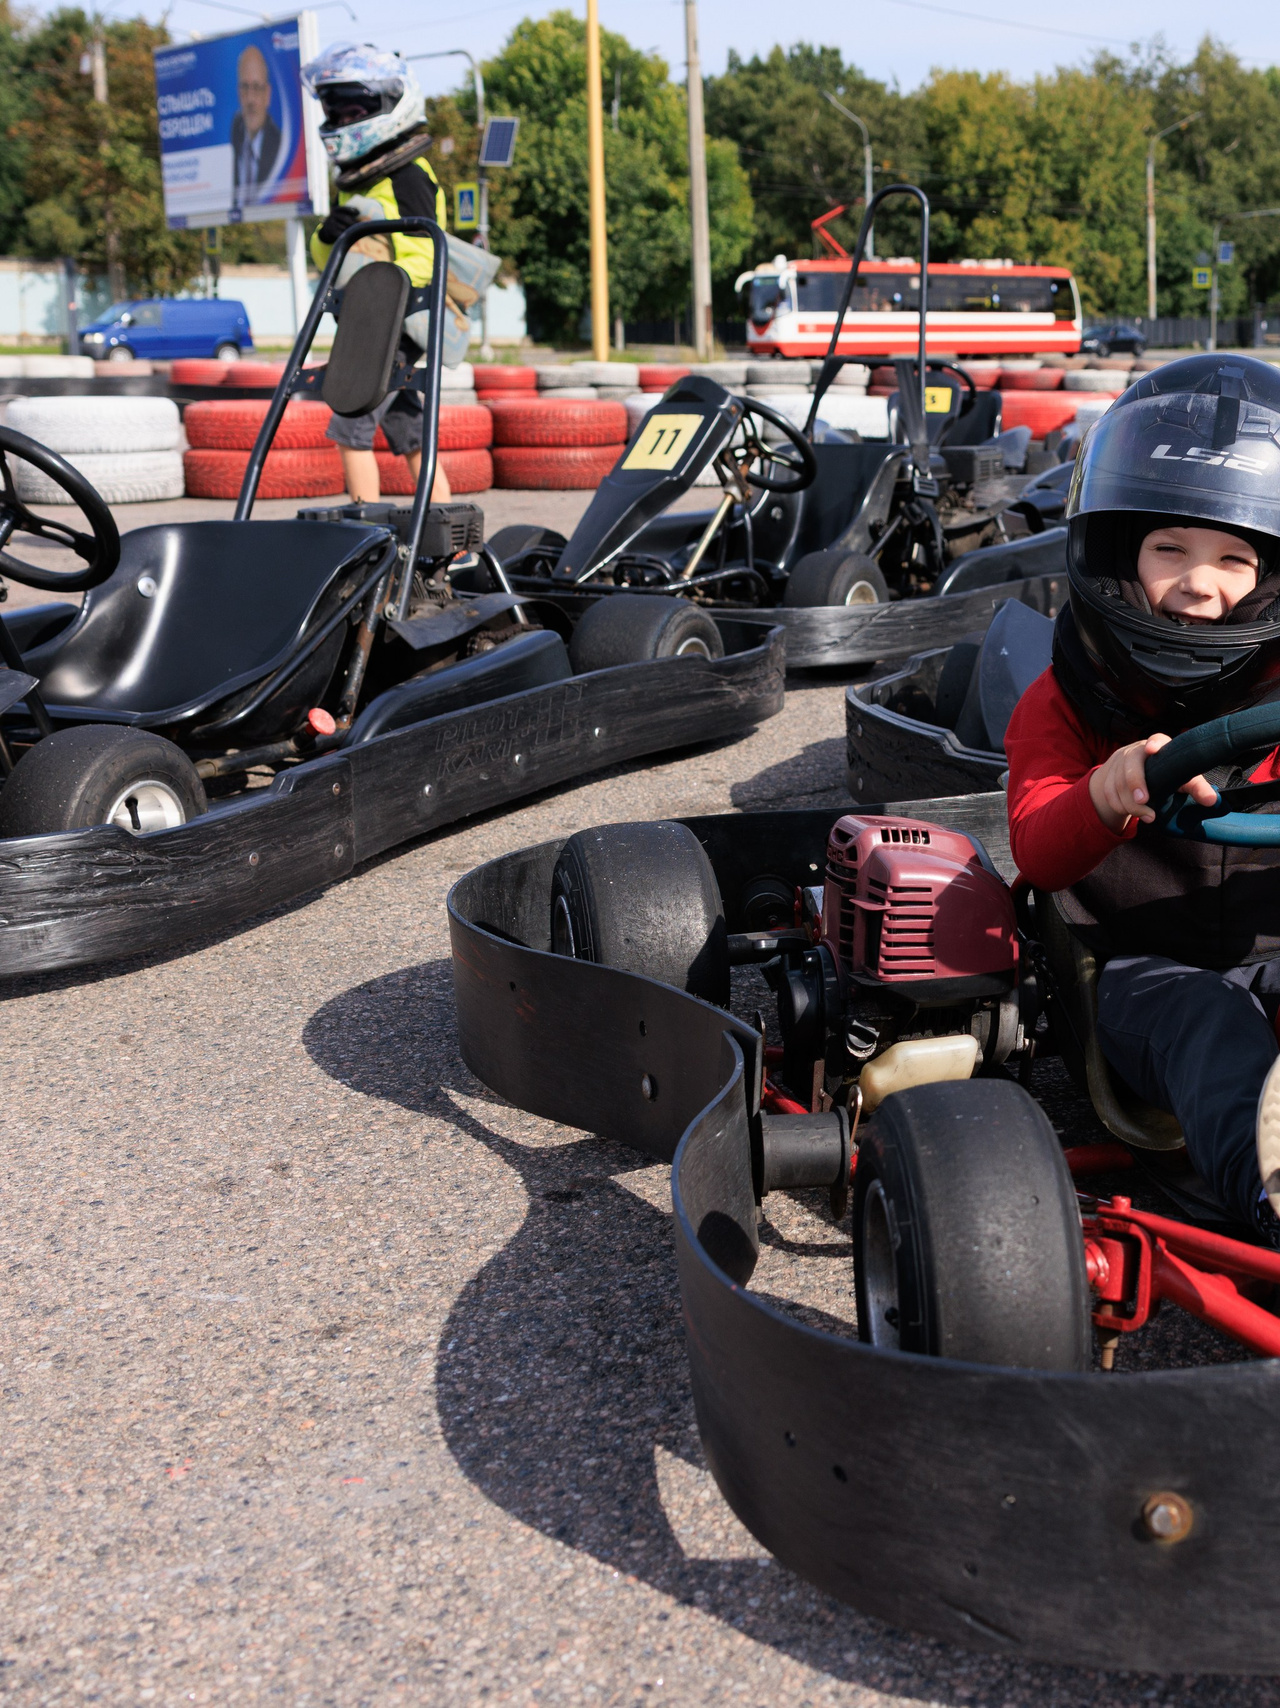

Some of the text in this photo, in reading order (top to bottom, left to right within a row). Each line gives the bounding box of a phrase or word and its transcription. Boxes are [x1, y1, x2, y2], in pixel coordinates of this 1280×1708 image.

[647, 427, 682, 456] 11
[1150, 444, 1270, 476] LS2
[435, 706, 524, 753] PILOT
[436, 735, 519, 781] KART
